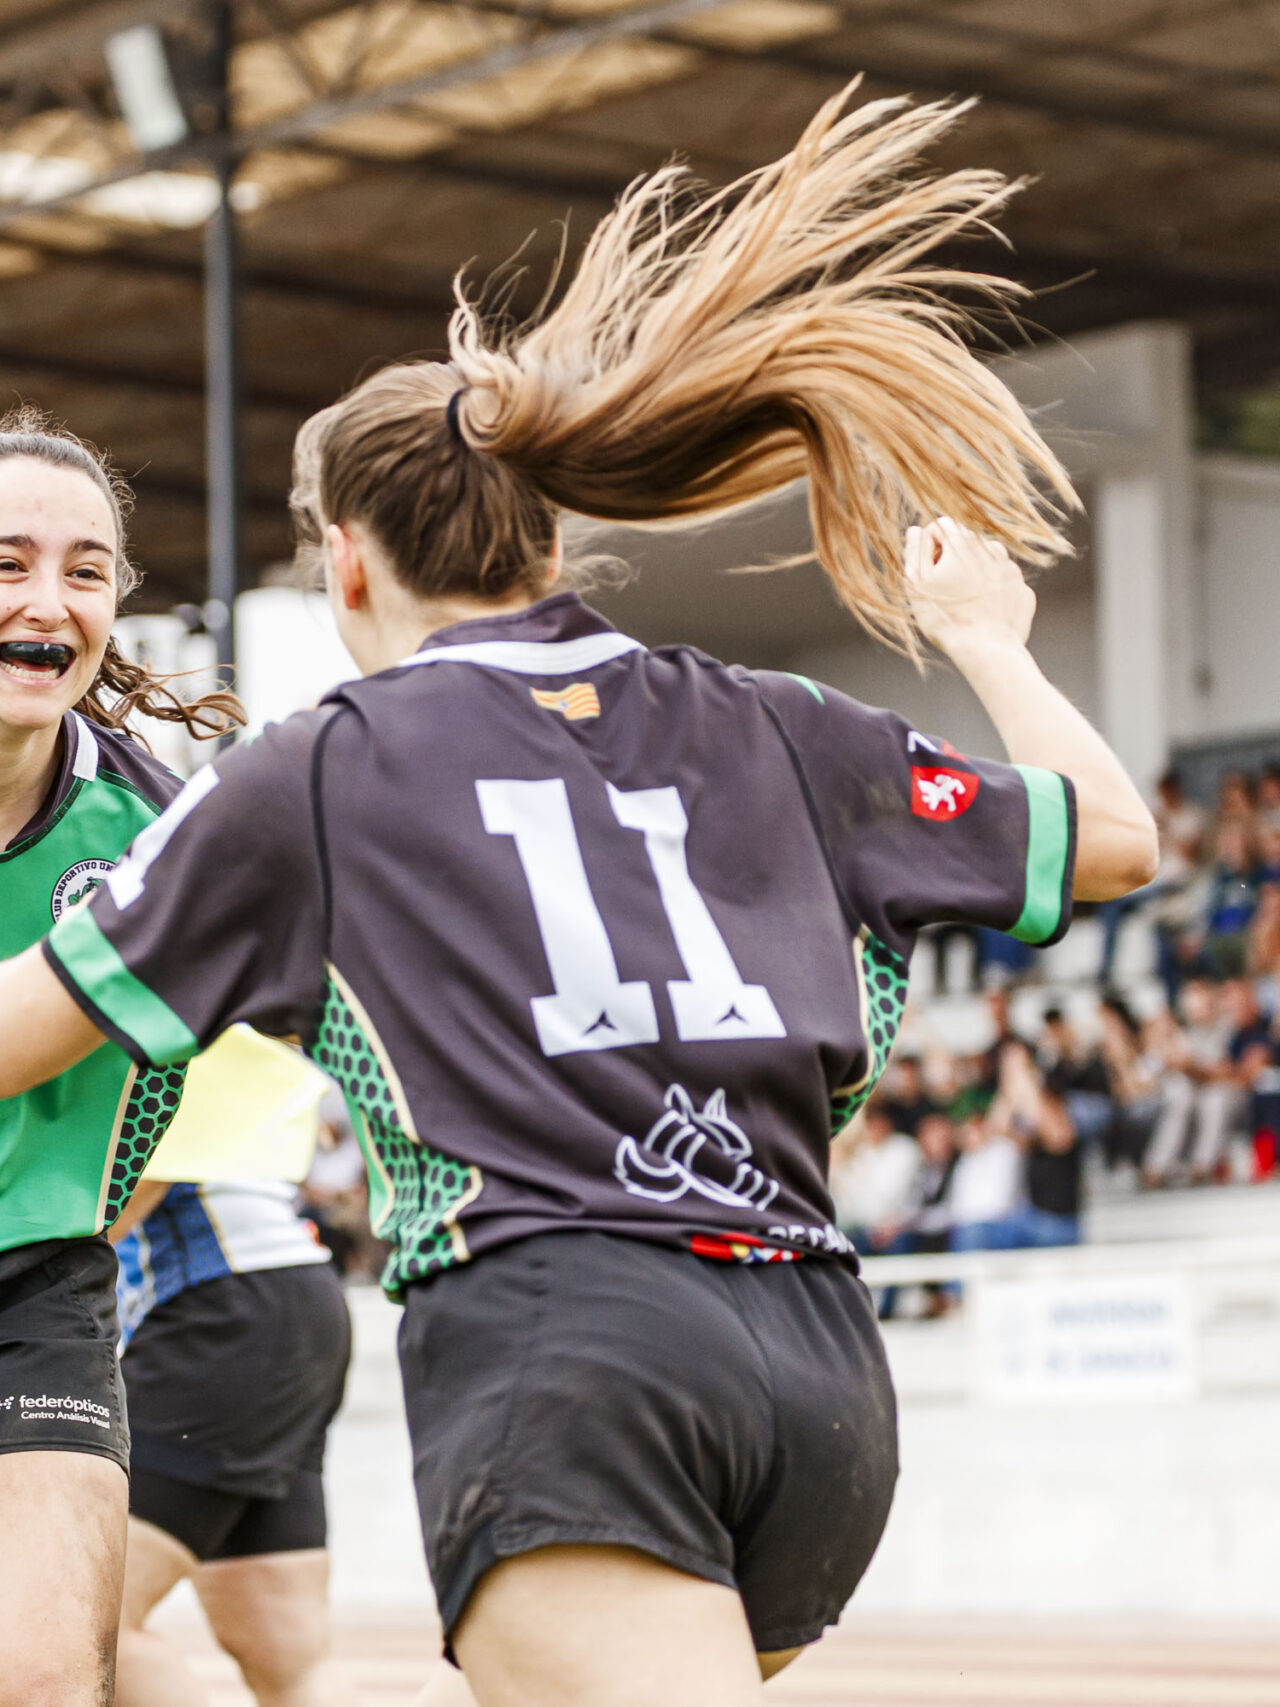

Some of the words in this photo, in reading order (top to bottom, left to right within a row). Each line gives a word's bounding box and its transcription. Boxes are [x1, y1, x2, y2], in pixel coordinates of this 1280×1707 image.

[55, 861, 97, 898] DEPORTIVO
[474, 777, 787, 1057] 11
[19, 1394, 110, 1418] federópticos
[21, 1411, 55, 1420] Centro
